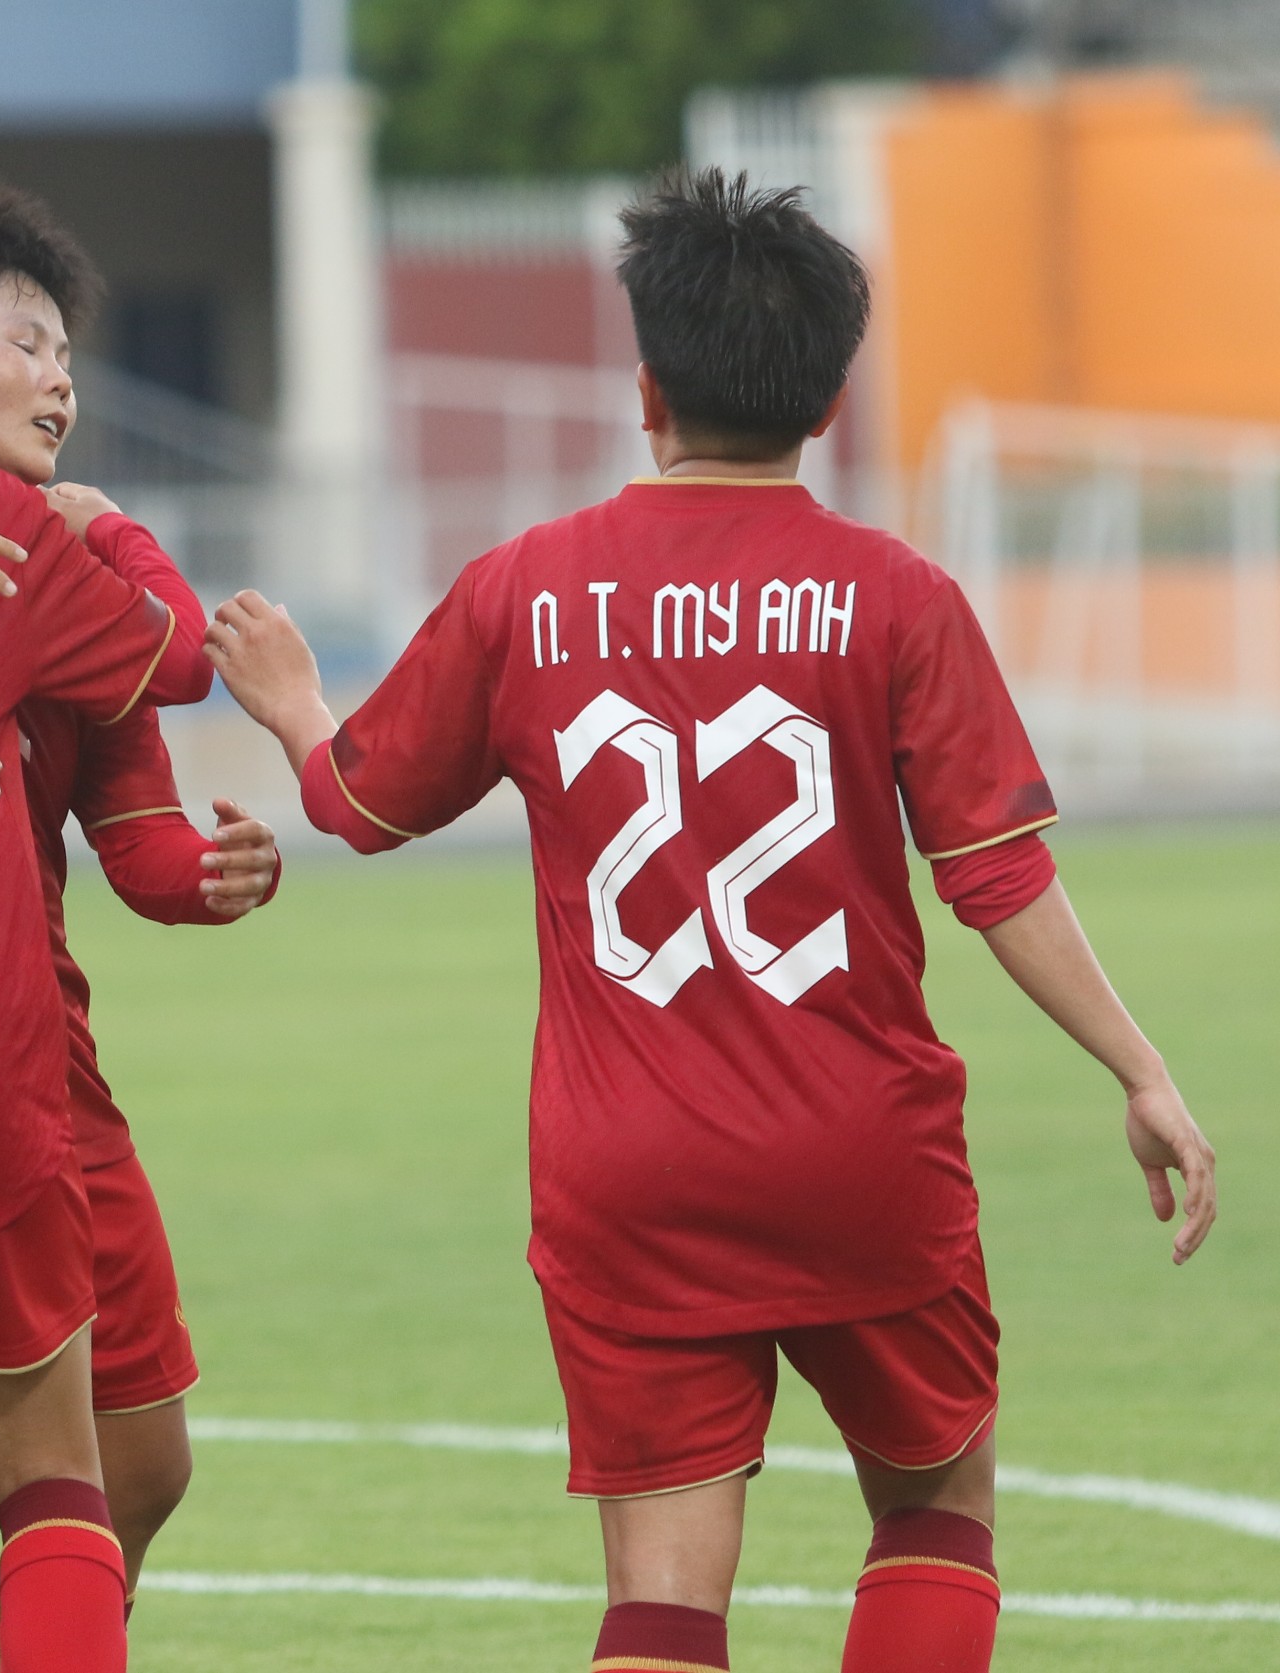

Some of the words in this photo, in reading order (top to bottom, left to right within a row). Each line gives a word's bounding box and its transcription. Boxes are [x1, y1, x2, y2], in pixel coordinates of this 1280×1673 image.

[586, 581, 632, 660] T.
[652, 577, 740, 659] MY
[757, 576, 857, 657] ANH
[552, 683, 850, 1009] 22
